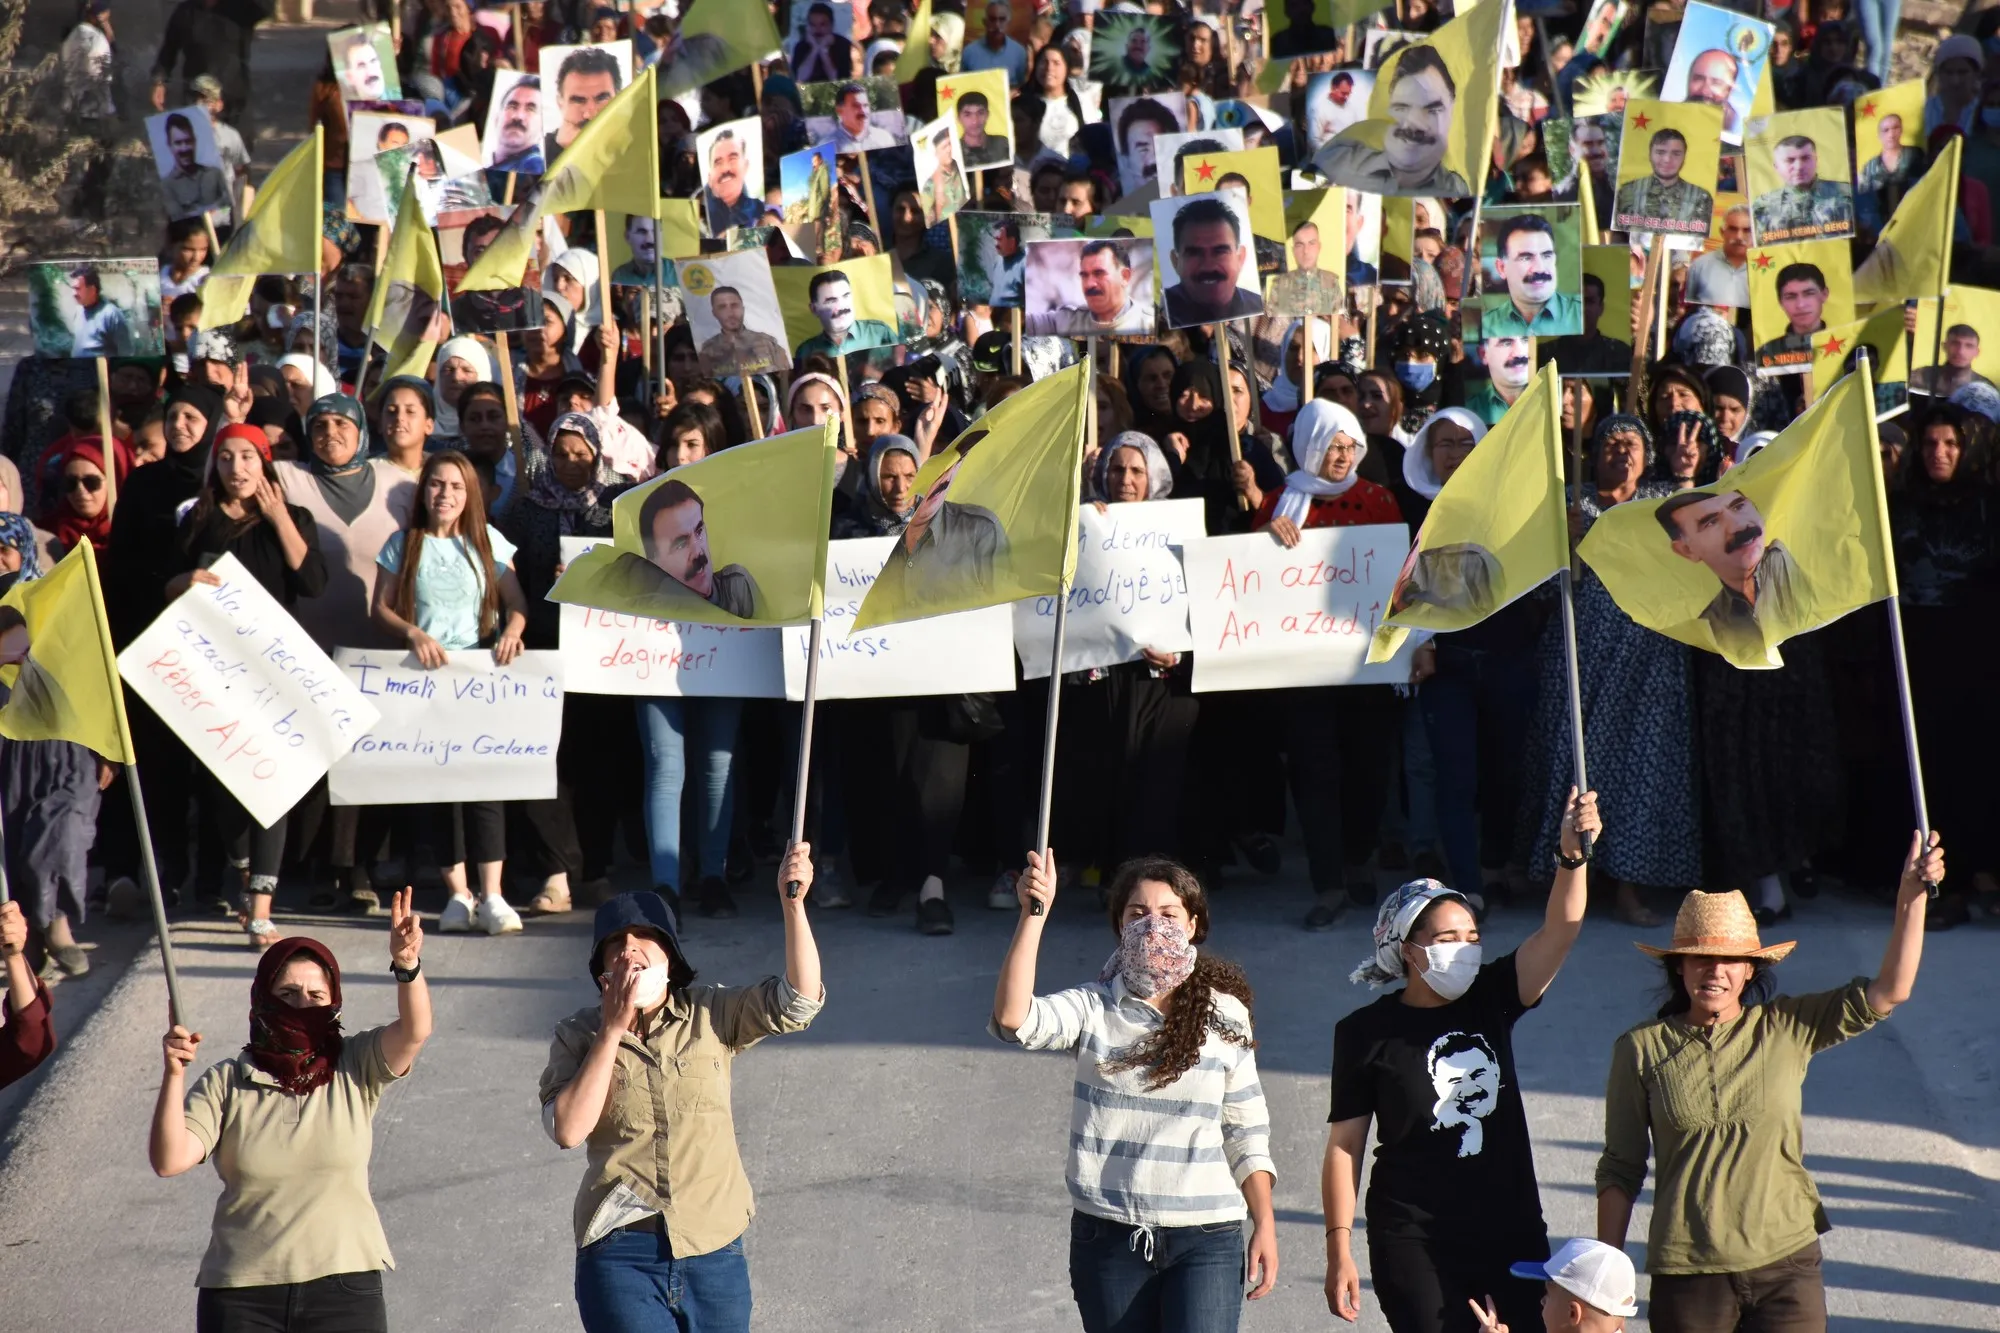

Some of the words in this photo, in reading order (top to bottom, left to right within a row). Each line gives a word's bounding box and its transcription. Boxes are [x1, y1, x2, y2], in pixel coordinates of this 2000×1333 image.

[1216, 558, 1261, 602] An
[1281, 547, 1376, 588] azadî
[1219, 610, 1260, 651] An
